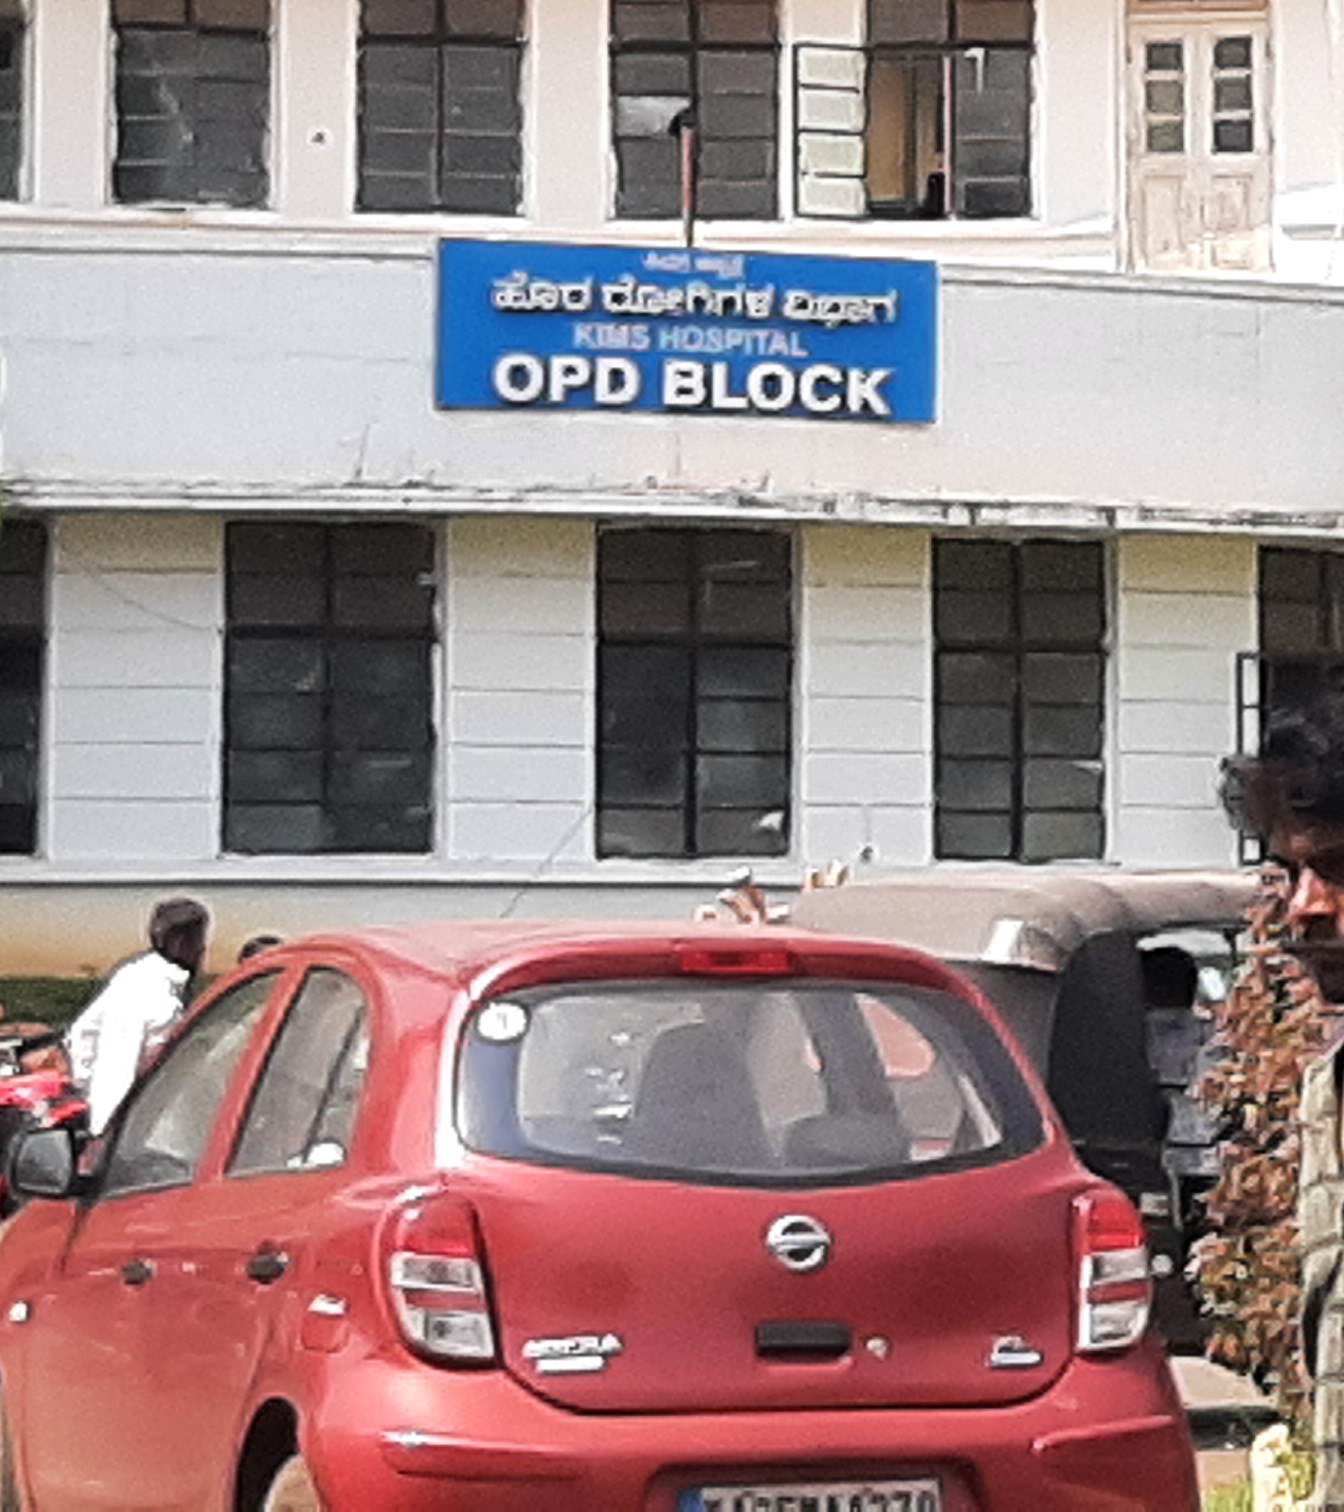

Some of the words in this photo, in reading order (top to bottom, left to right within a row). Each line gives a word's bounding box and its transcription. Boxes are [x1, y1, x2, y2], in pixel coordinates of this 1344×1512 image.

[573, 322, 651, 351] KIMS
[659, 326, 808, 357] HOSPITAL
[494, 354, 640, 405] OPD
[662, 358, 892, 415] BLOCK
